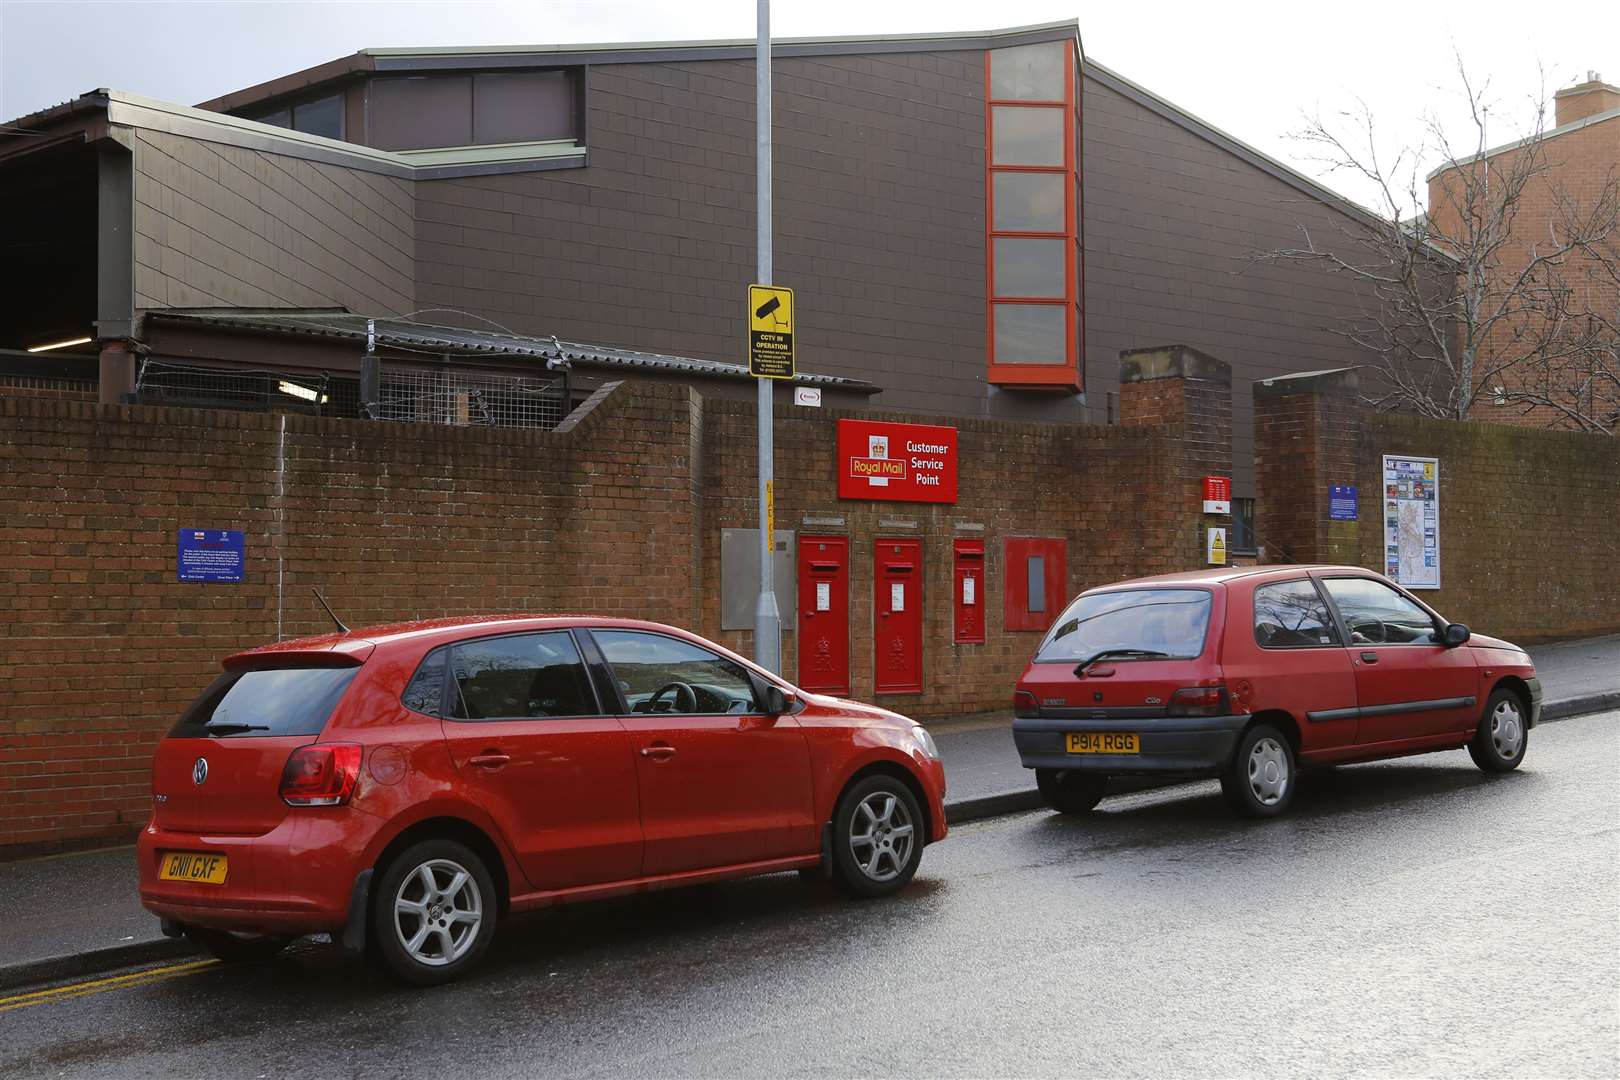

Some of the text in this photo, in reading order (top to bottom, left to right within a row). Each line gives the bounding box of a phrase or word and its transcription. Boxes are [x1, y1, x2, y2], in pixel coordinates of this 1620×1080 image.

[756, 342, 788, 350] OPERATION
[906, 440, 949, 454] Customer
[854, 460, 903, 475] Royal Mail
[911, 457, 944, 470] Service
[916, 473, 940, 486] Point
[1071, 735, 1134, 750] P914 RGG
[191, 857, 220, 879] GXF
